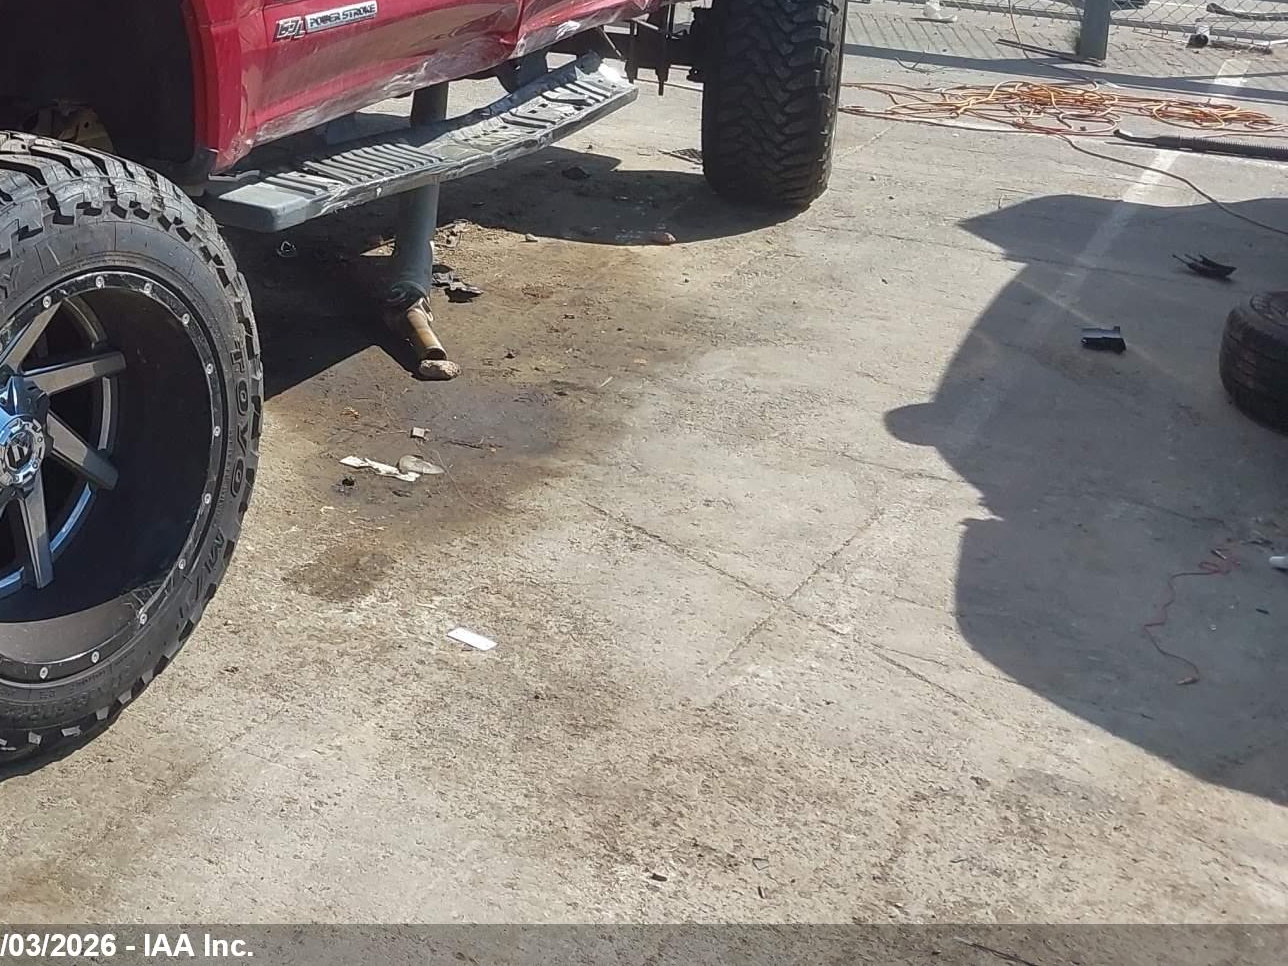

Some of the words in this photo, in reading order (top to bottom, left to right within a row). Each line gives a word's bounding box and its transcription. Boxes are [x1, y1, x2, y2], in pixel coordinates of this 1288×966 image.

[309, 12, 341, 27] POWER
[342, 3, 376, 21] STROKE
[229, 340, 249, 498] TOYO
